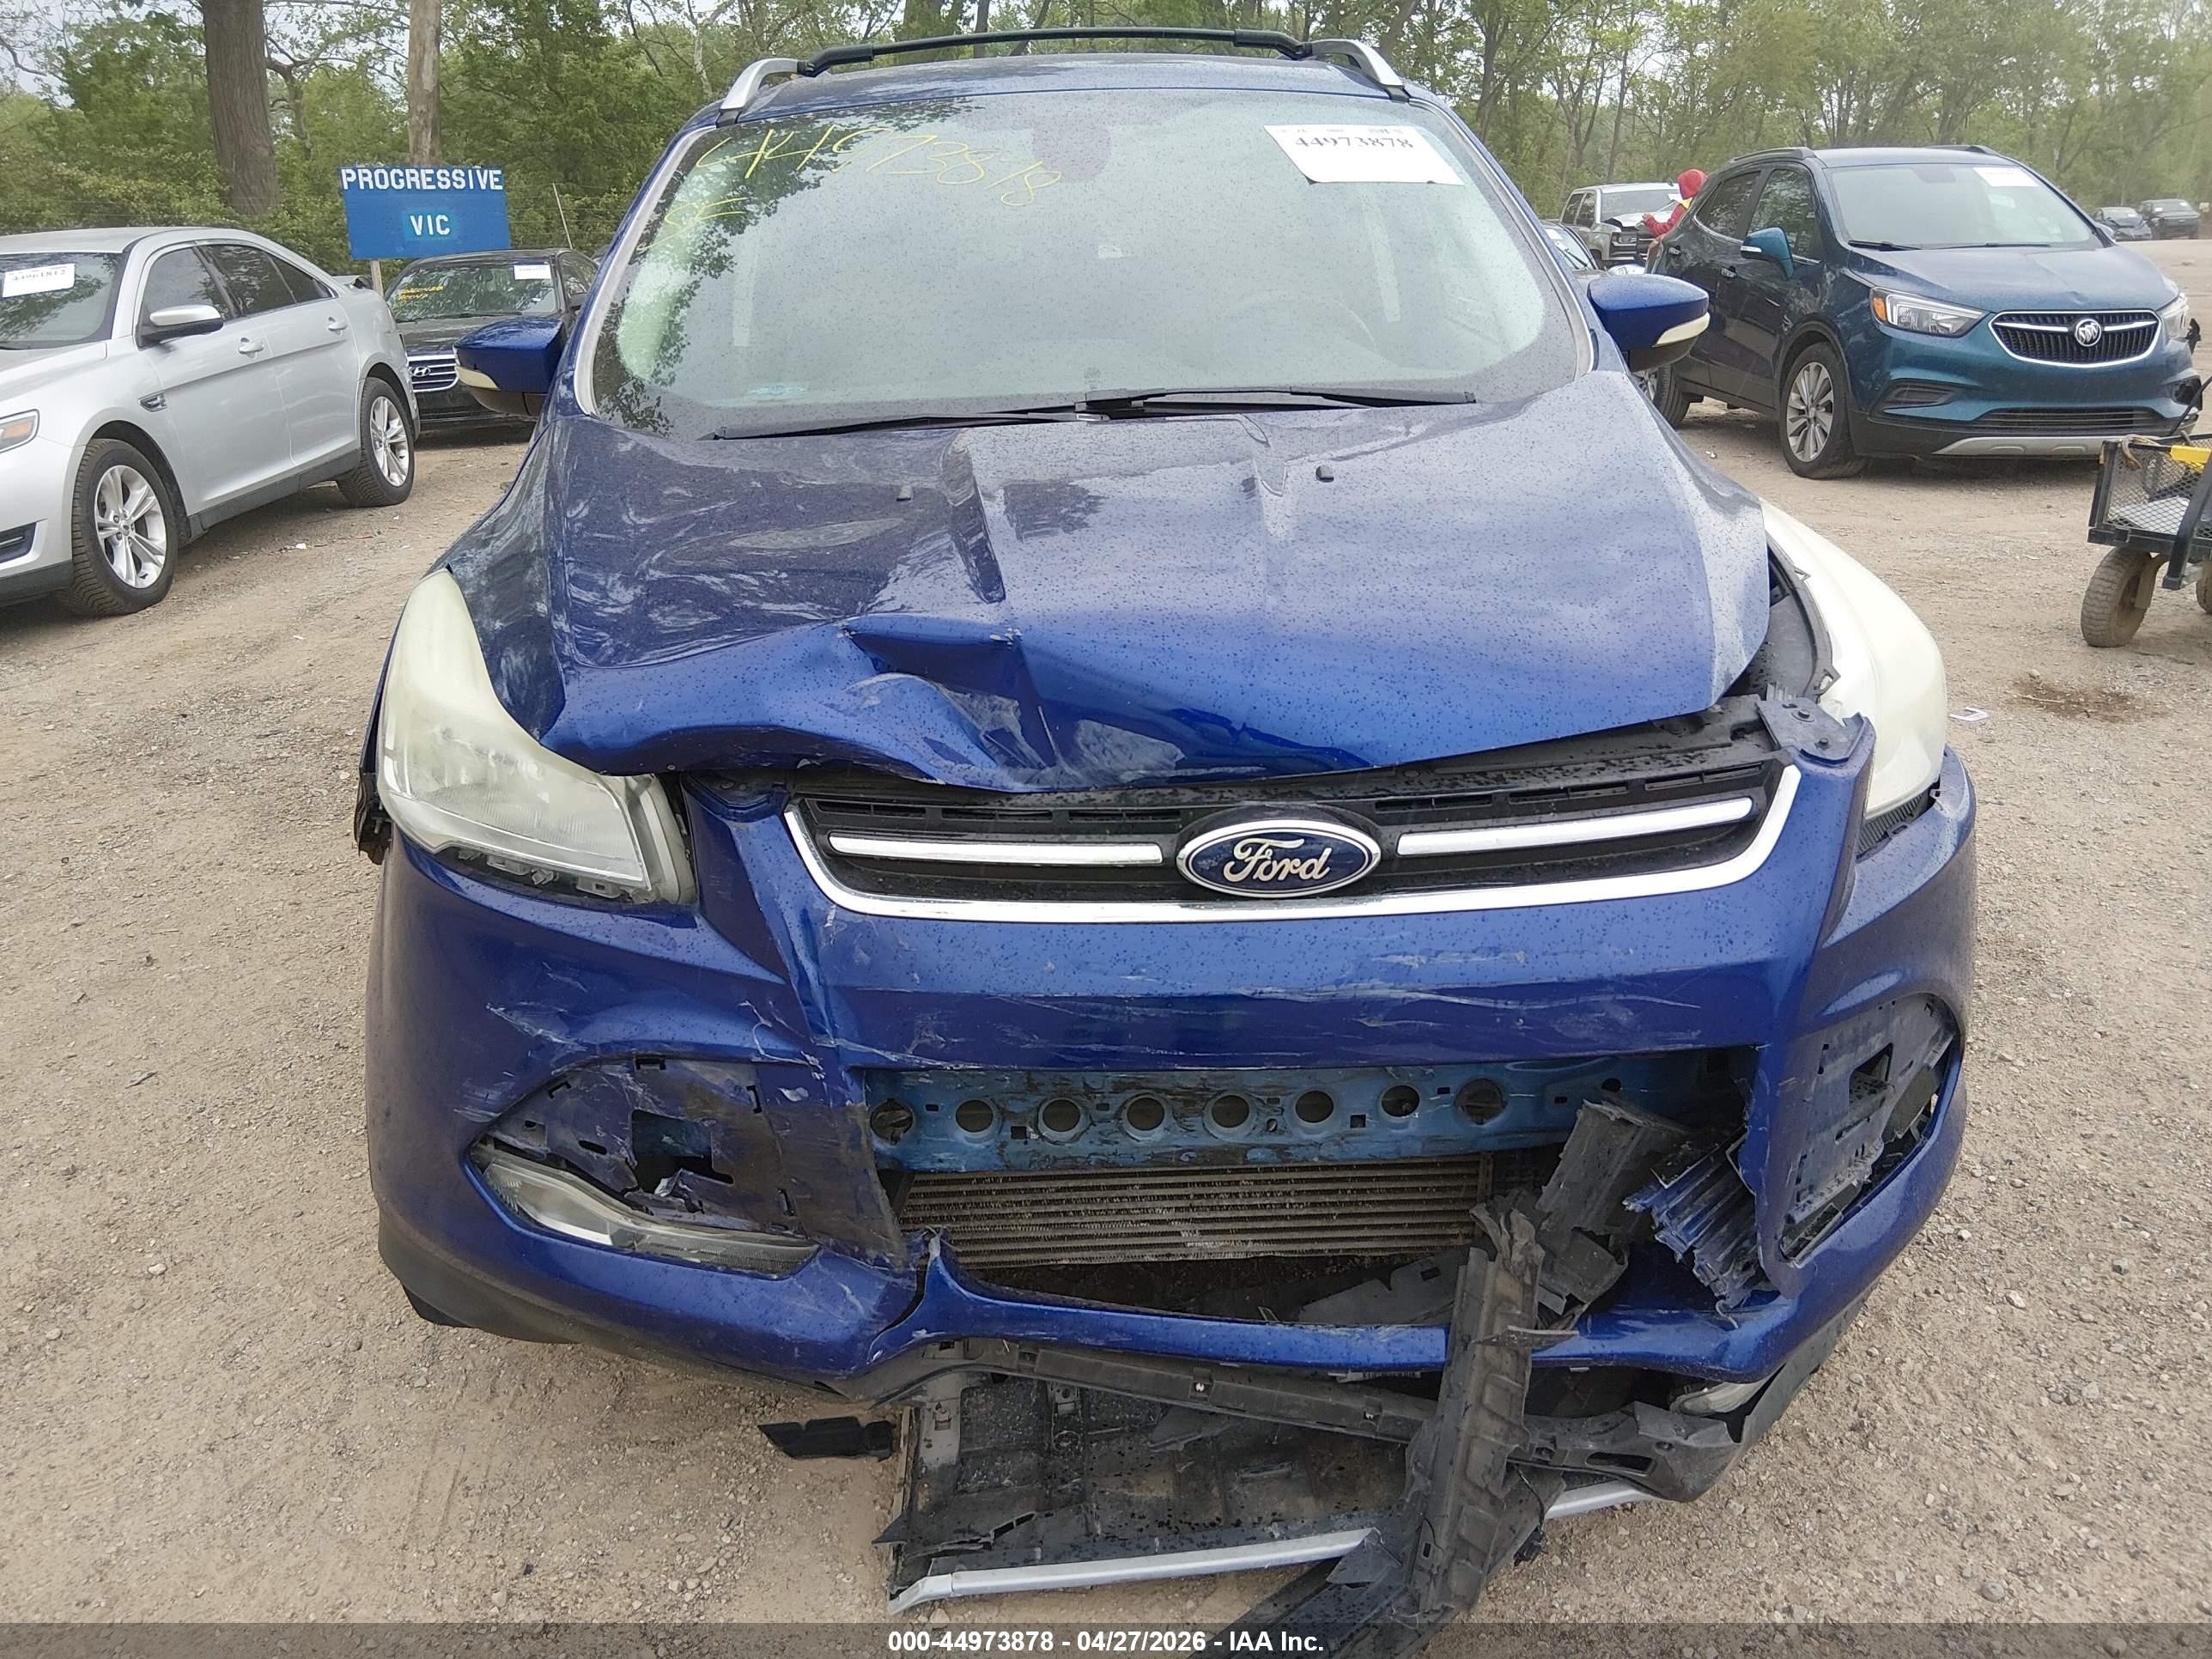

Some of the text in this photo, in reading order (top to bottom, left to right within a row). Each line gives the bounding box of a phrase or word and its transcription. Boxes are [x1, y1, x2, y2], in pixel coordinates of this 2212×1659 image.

[1295, 137, 1414, 149] 44973878
[341, 167, 504, 191] PROGRESSIVE
[410, 215, 452, 236] VIC
[1223, 837, 1333, 883] Ford
